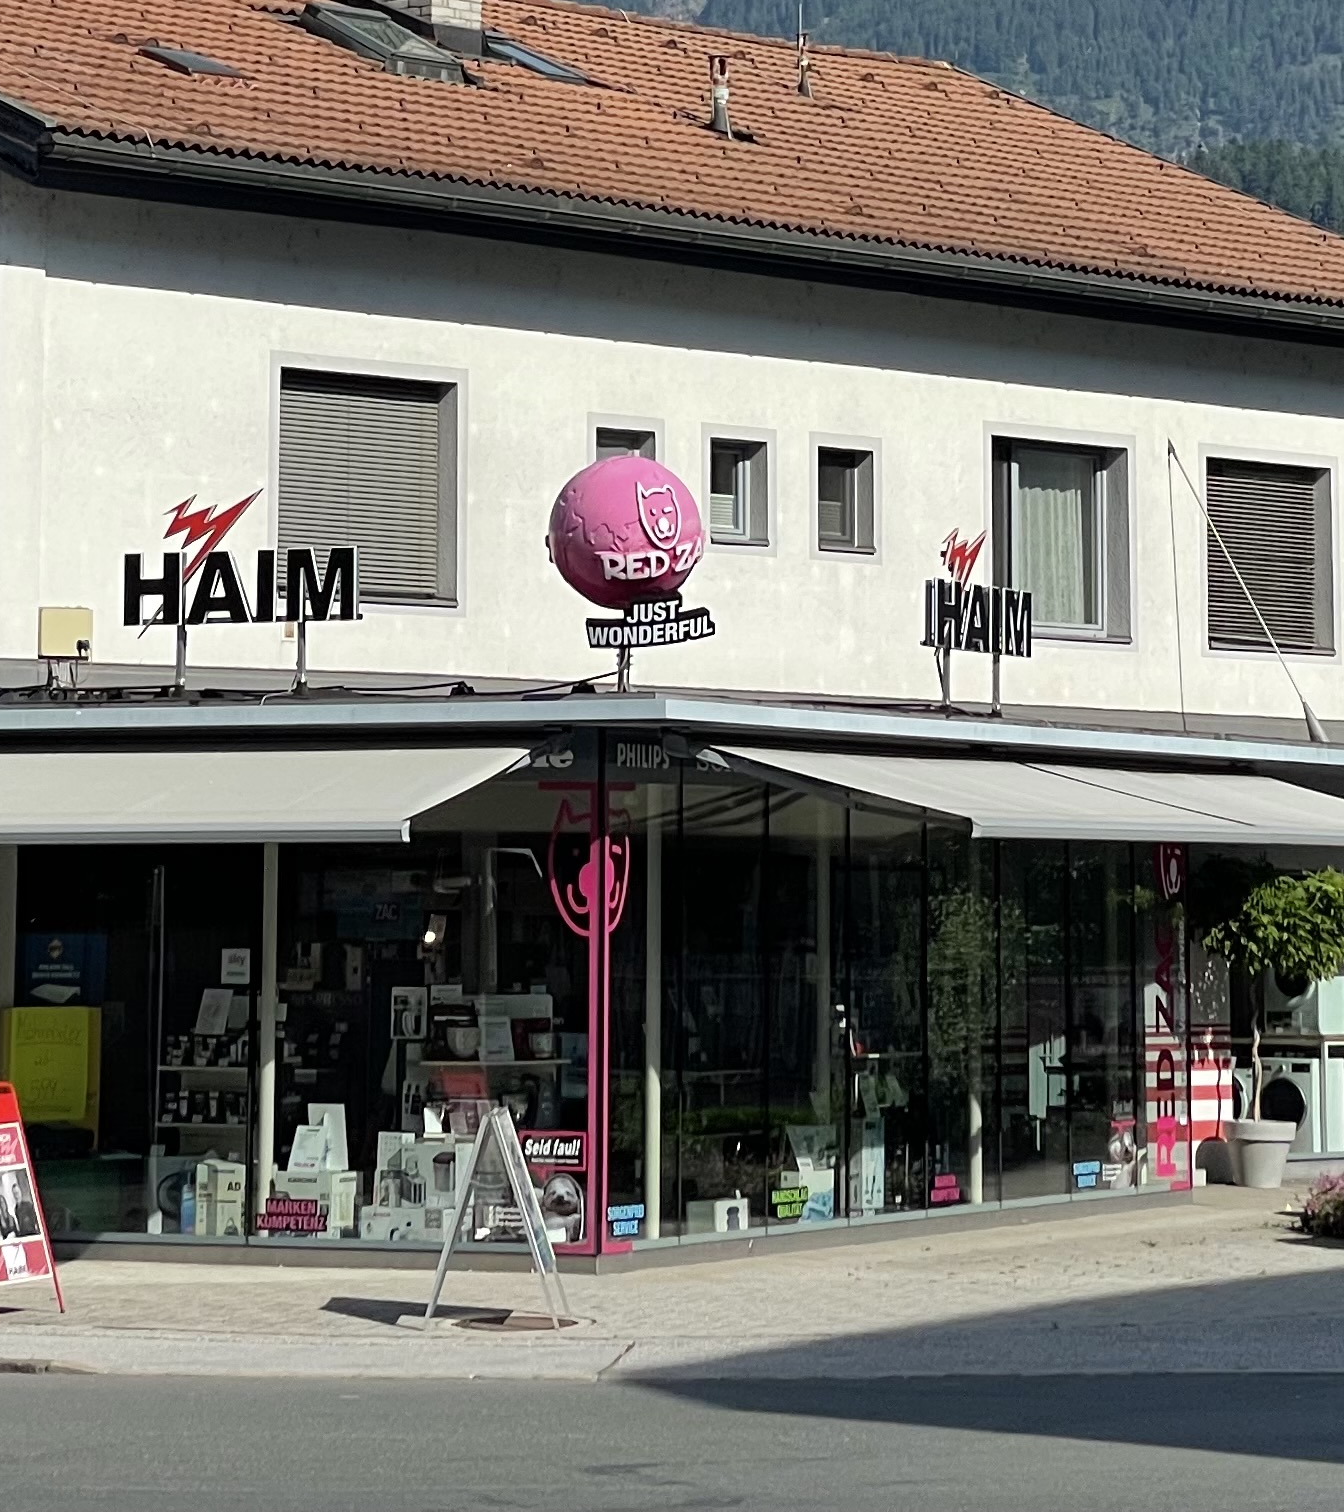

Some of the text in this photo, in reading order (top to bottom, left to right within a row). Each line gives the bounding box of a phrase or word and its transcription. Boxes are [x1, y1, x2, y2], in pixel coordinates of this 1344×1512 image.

[594, 548, 670, 580] RED
[123, 546, 360, 626] HAIM
[626, 600, 680, 624] JUST
[933, 577, 1032, 658] HAIM
[588, 615, 714, 646] WONDERFUL
[617, 742, 670, 769] PHILIPS
[375, 903, 399, 921] ZAC
[1155, 1049, 1177, 1177] RED
[524, 1138, 581, 1157] Seid faul!
[267, 1198, 316, 1215] MARKEN
[256, 1214, 325, 1230] KOMPETENZ
